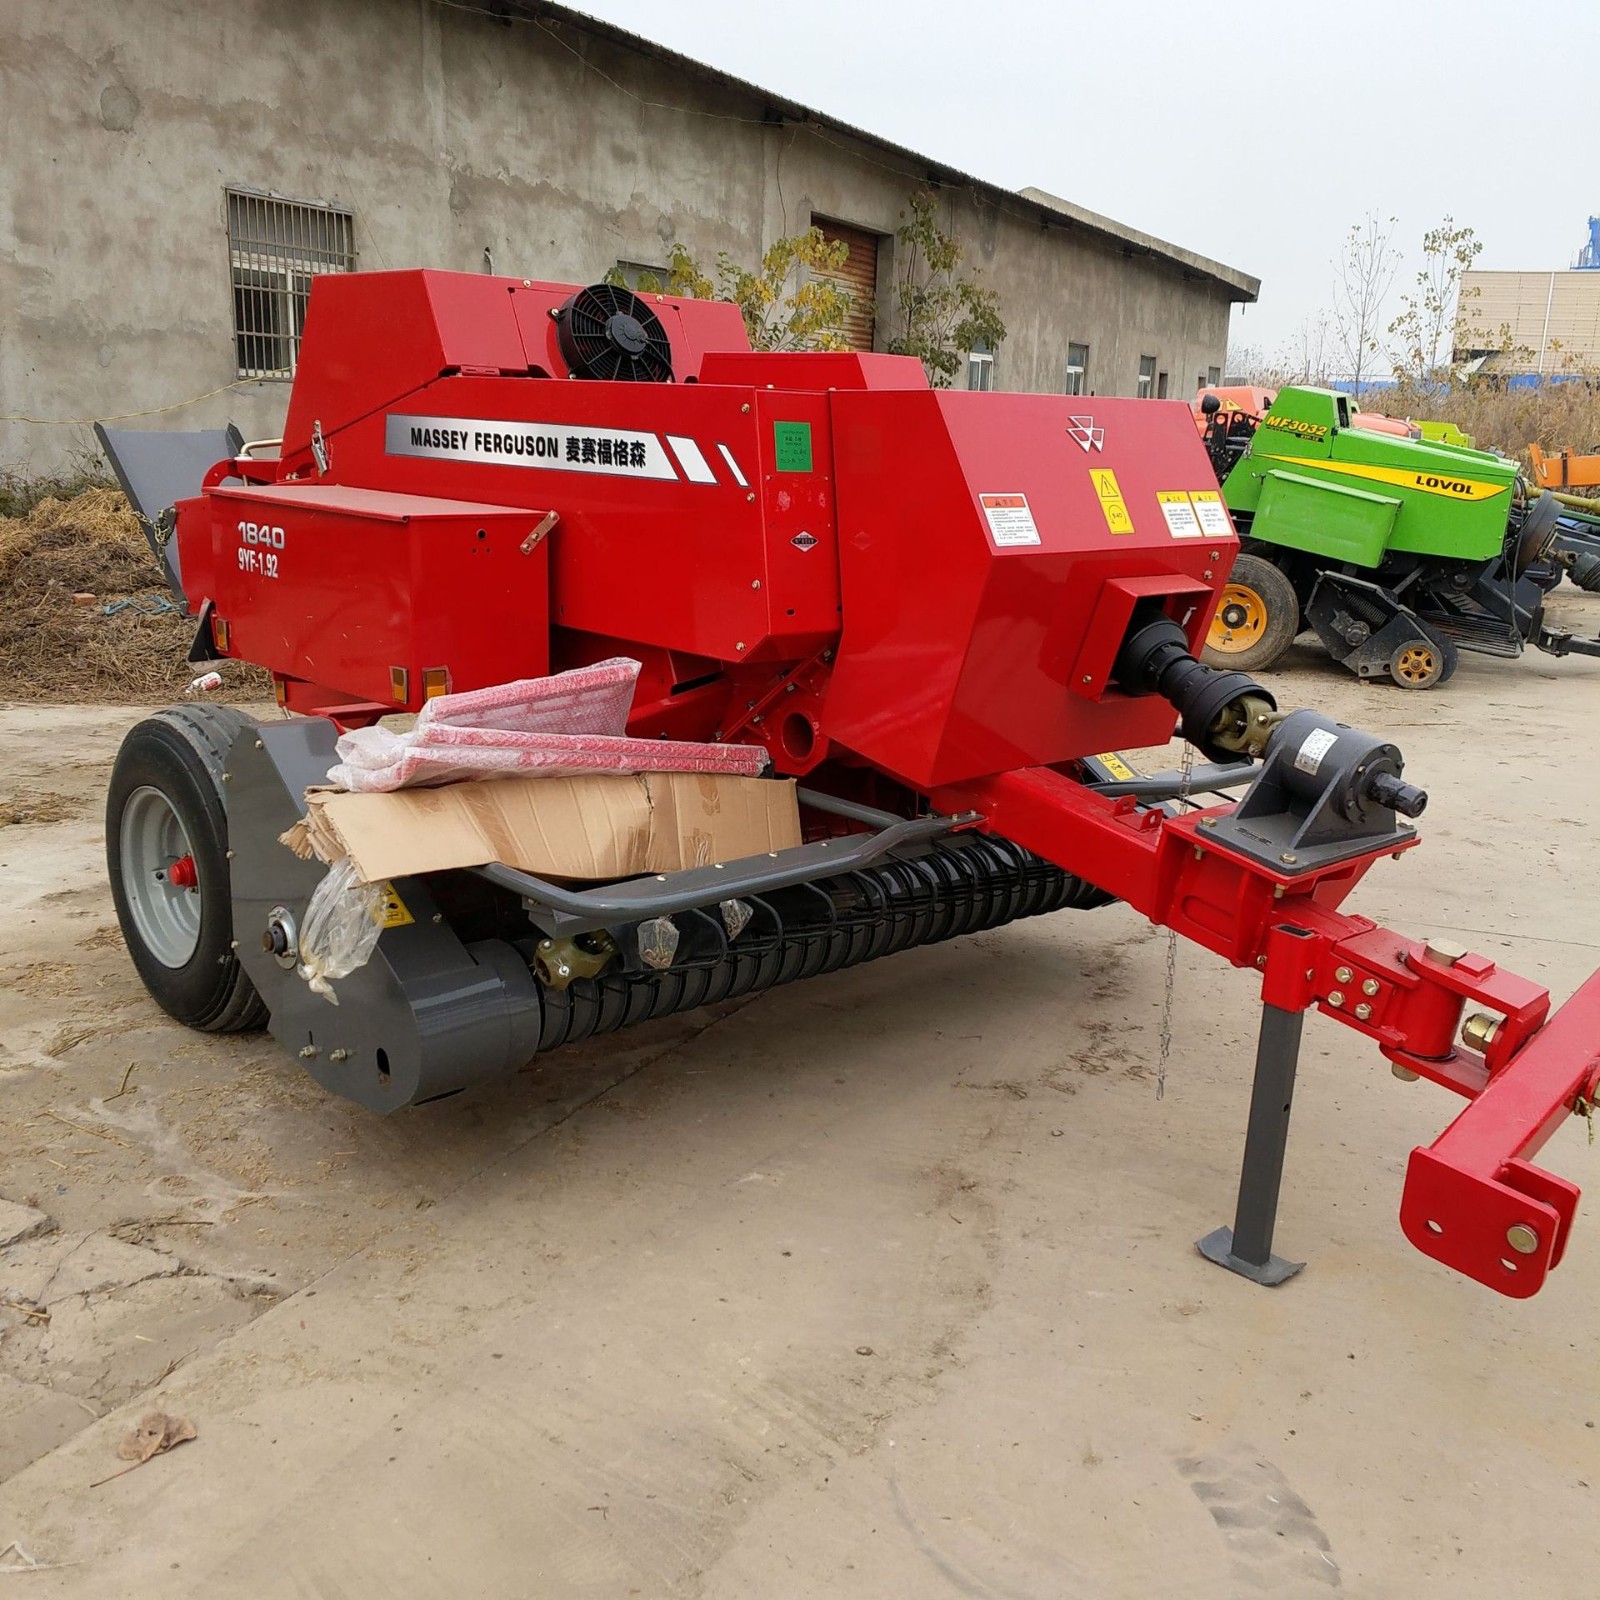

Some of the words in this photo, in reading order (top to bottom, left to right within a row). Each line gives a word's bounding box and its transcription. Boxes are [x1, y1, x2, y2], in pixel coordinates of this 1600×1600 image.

[1266, 415, 1328, 436] MF3032
[411, 427, 469, 450] MASSEY
[474, 433, 559, 459] FERGUSON
[566, 436, 646, 468] 麦赛福格森
[1416, 475, 1474, 495] LOVOL
[237, 521, 285, 549] 1840
[238, 547, 278, 579] 9YF-1.92
